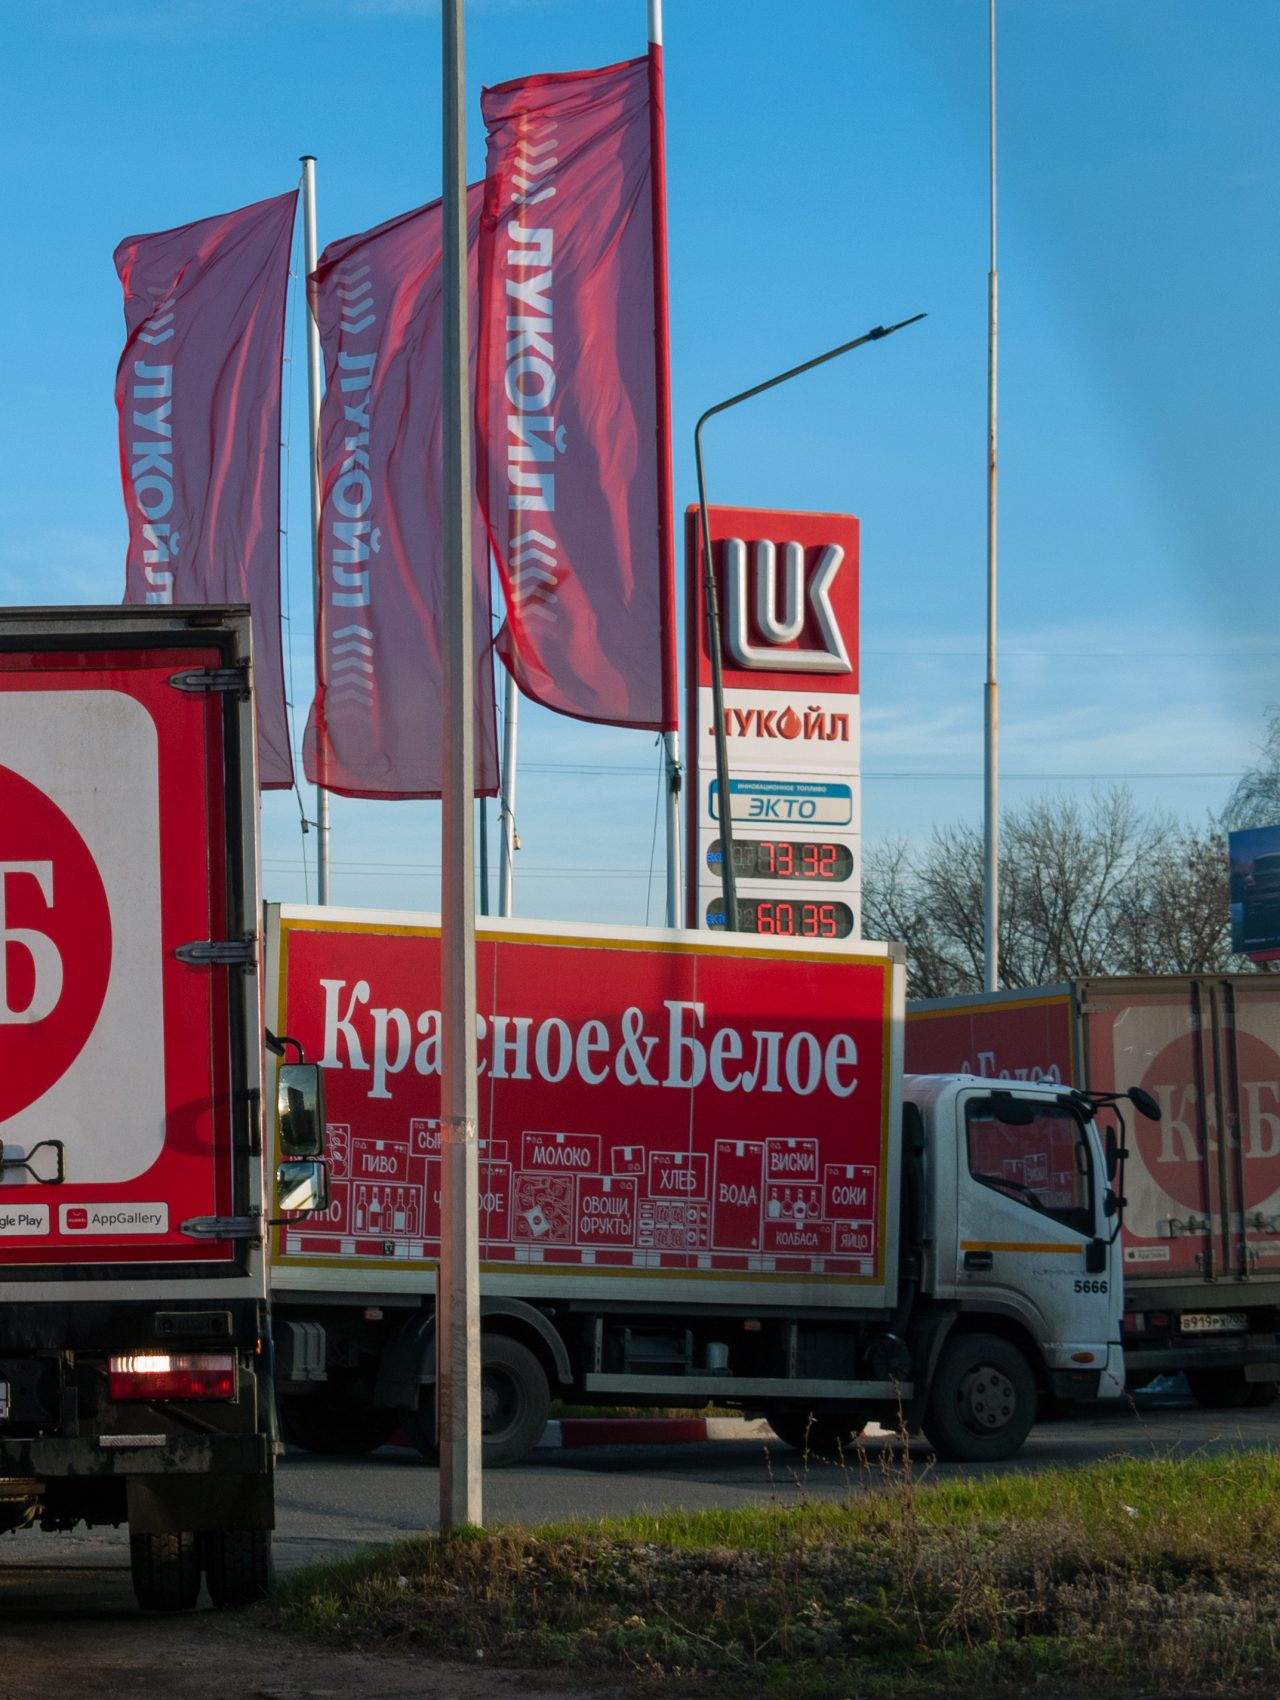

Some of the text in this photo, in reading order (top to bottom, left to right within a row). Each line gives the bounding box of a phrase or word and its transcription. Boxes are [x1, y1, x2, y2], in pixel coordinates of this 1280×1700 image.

[505, 221, 567, 512] ЛУКОЙЛ
[132, 361, 180, 604] ЛУКОЙЛ
[748, 798, 816, 818] ЭКТО
[760, 842, 836, 876] 73.32
[757, 903, 836, 937] 60.35
[317, 978, 858, 1099] Краное&Белое
[362, 1154, 398, 1174] ПИВО
[533, 1146, 591, 1167] МОЛОКО
[771, 1152, 814, 1171] ВИСКИ
[659, 1169, 697, 1191] ХЛЕБ
[719, 1183, 757, 1206] ВОДА
[831, 1185, 867, 1206] СОКИ
[18, 1214, 43, 1228] Play
[92, 1212, 162, 1226] AppGallery
[580, 1215, 632, 1236] ФРУКТЫ
[775, 1231, 818, 1246] КОЛБАСА
[1074, 1280, 1108, 1294] 5666
